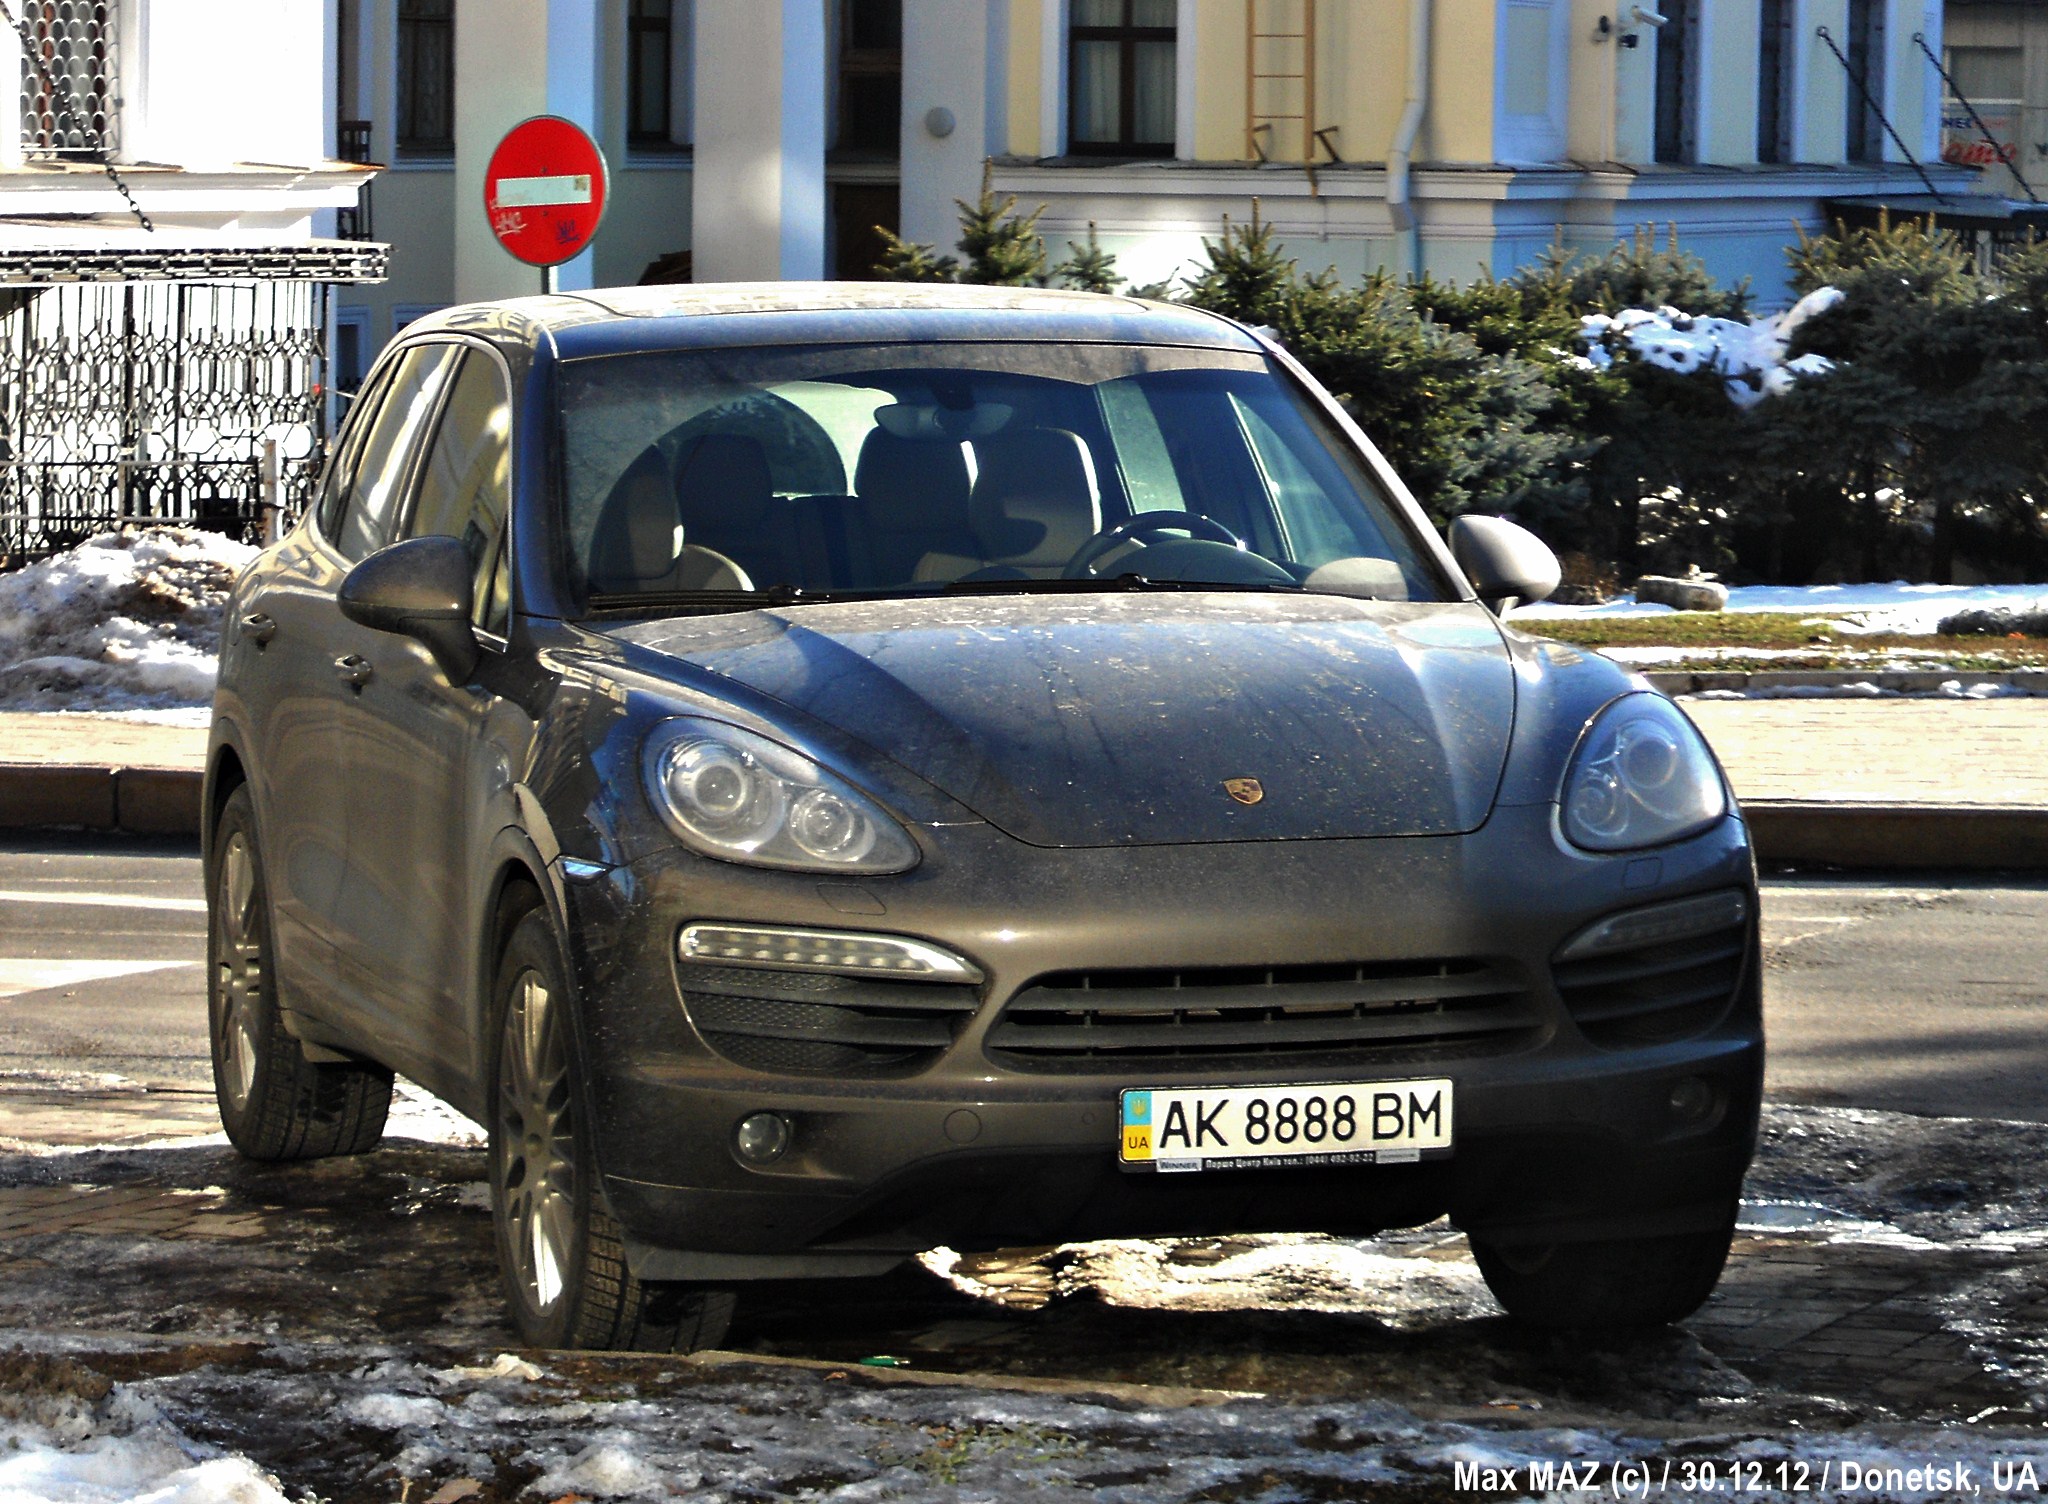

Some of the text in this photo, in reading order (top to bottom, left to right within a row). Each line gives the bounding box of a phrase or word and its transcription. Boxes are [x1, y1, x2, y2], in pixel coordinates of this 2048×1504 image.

[1159, 1090, 1442, 1149] AK 8888 BM
[1128, 1136, 1149, 1149] UA
